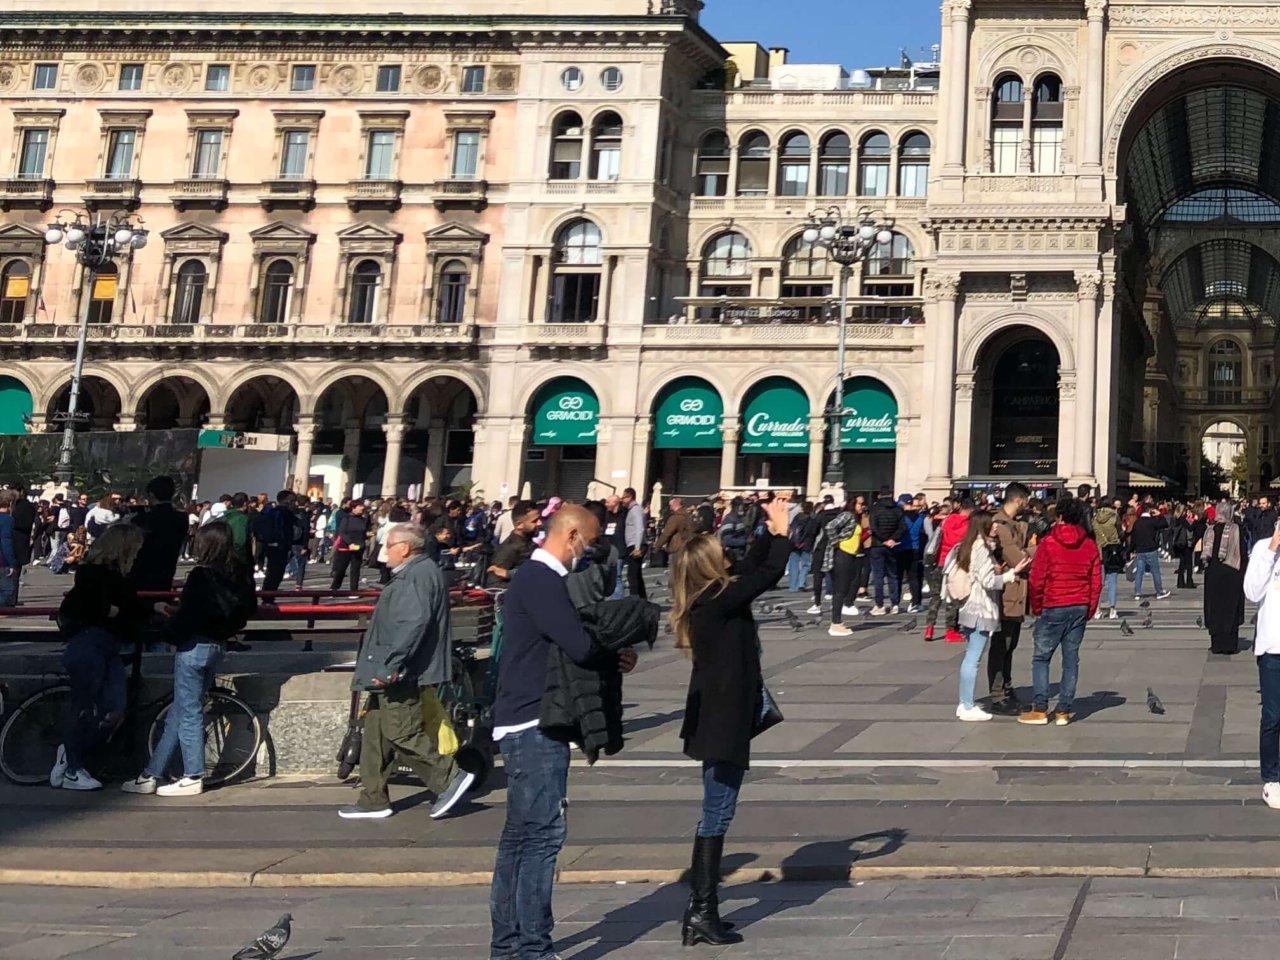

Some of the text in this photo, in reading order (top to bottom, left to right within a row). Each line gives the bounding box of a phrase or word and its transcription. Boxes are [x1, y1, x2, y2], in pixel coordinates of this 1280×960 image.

[546, 410, 594, 421] GRIMOLDI
[666, 414, 716, 426] GRIMOLDI
[747, 412, 805, 437] Currado
